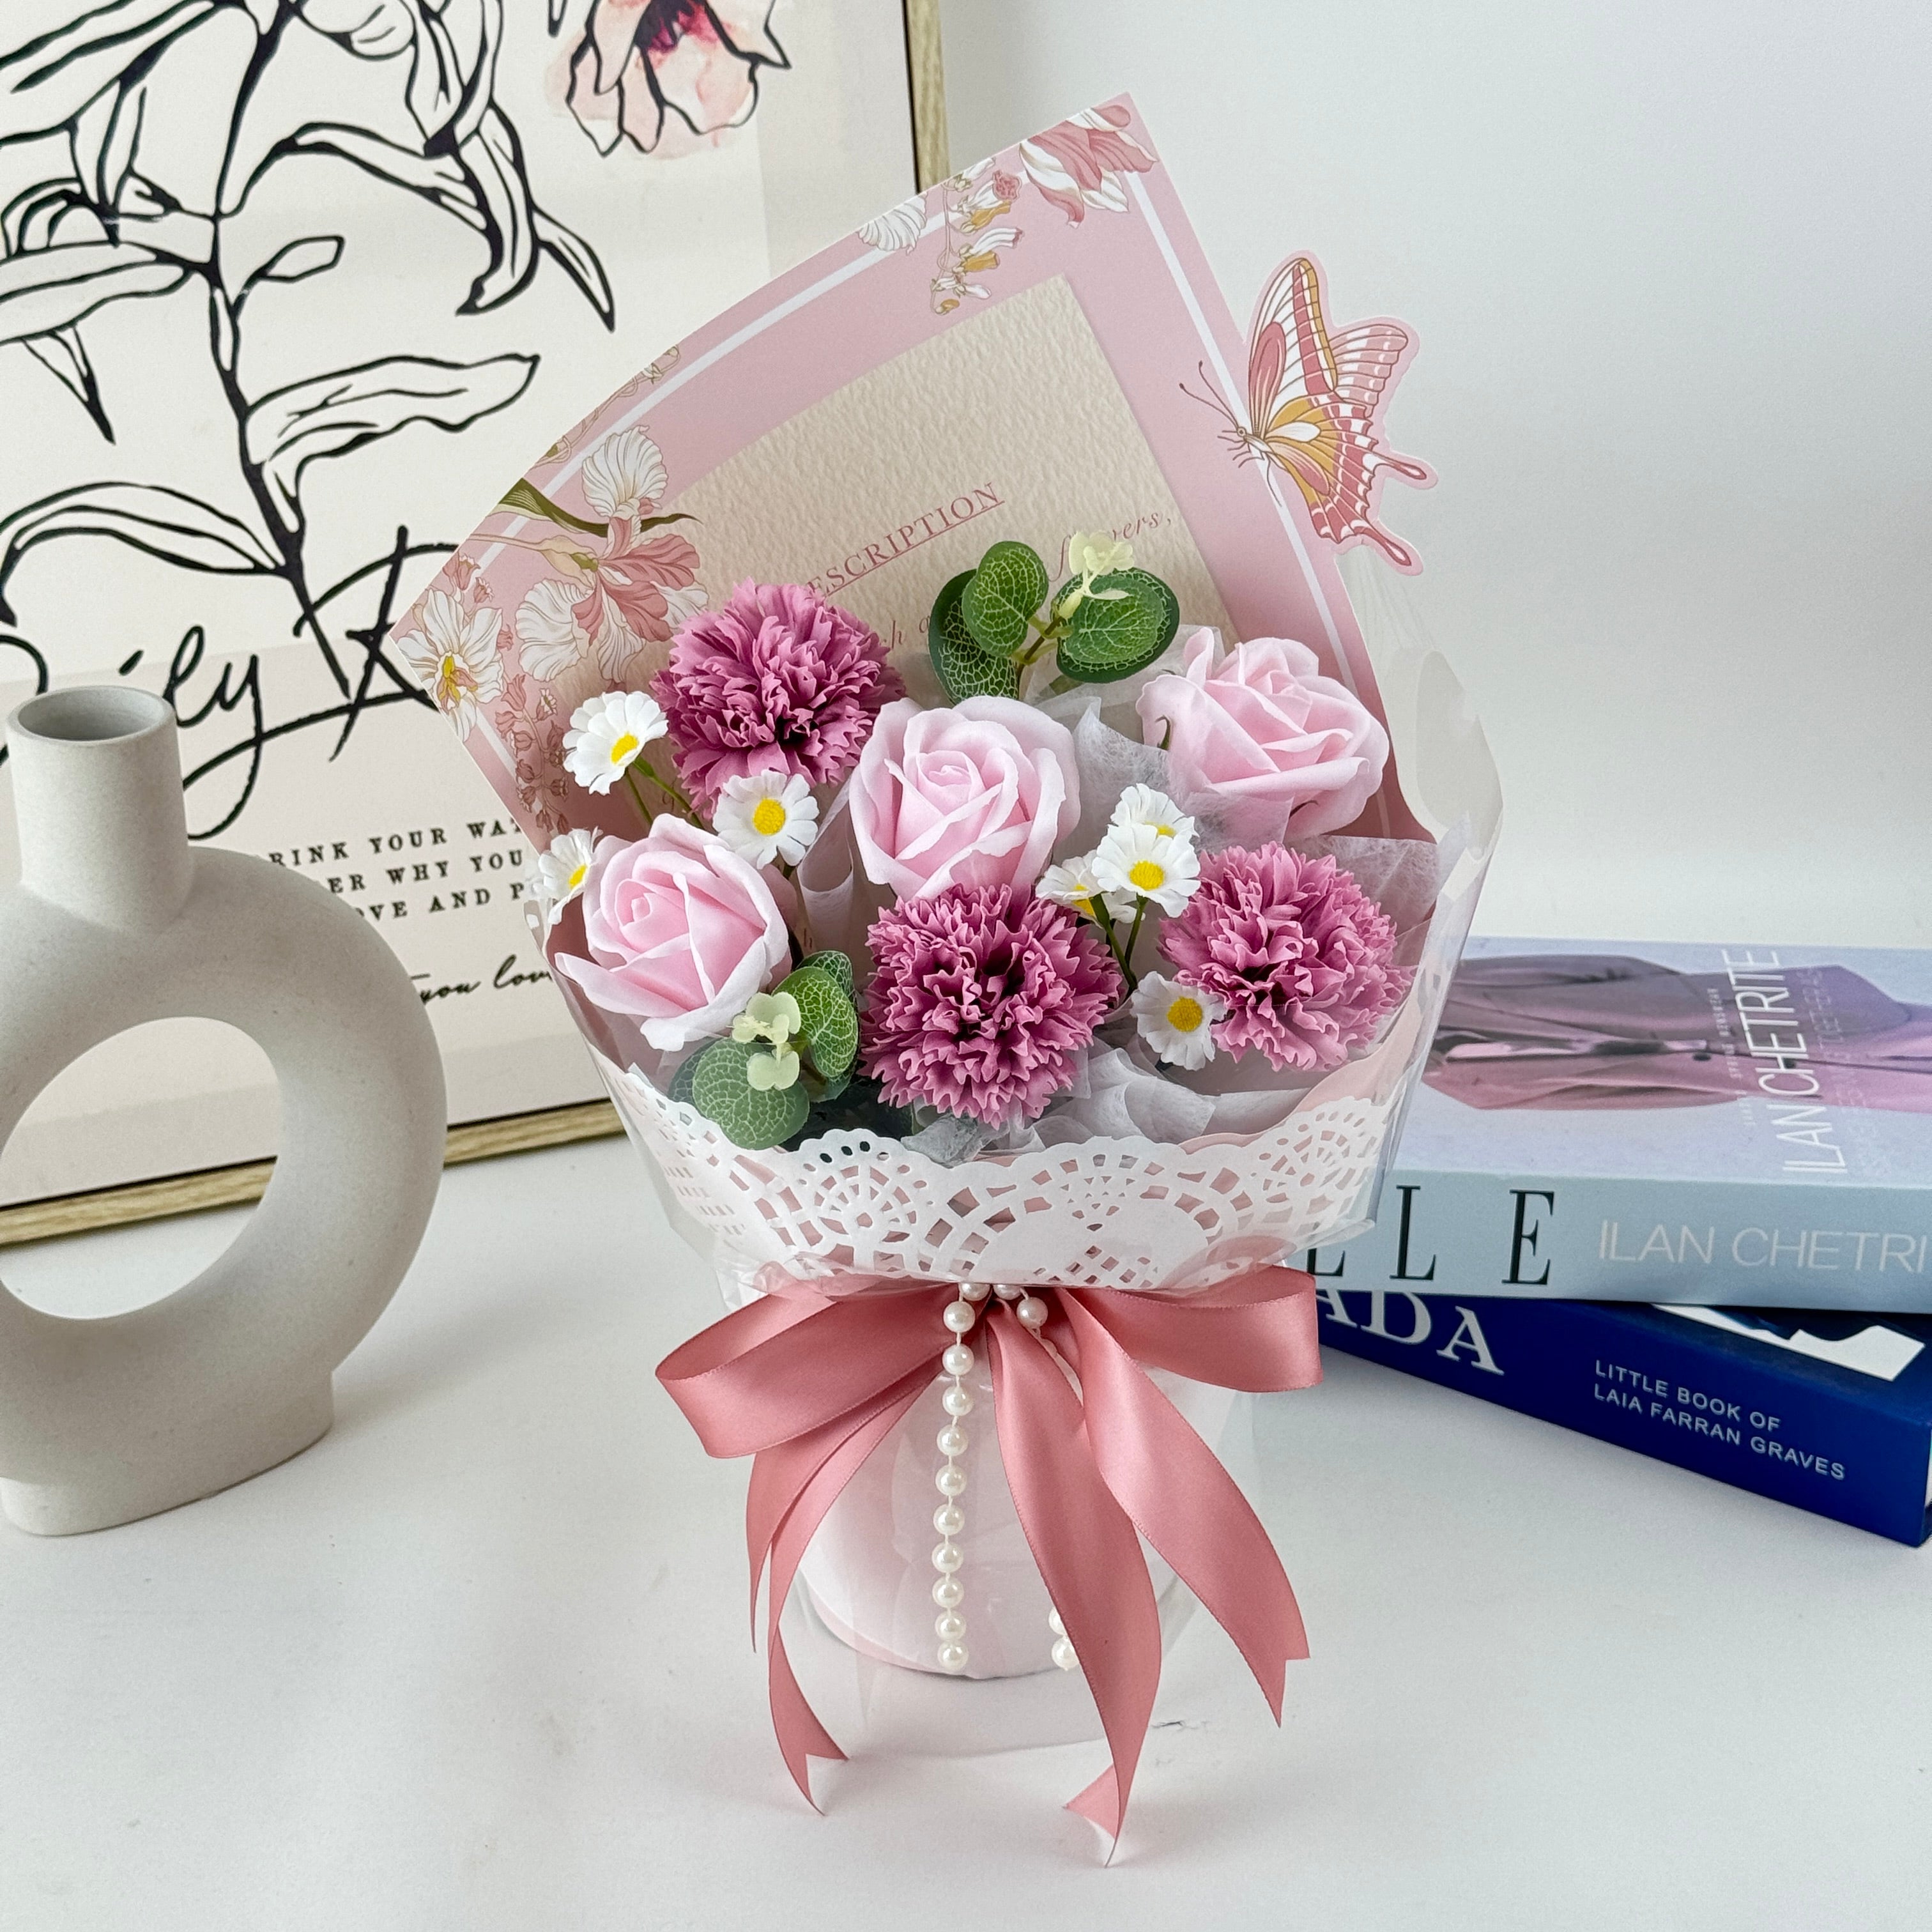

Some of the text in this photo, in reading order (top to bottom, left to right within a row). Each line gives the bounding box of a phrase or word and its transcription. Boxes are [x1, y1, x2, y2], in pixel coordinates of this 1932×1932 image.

[369, 827, 447, 854] YOUR
[386, 860, 449, 885] WHY
[470, 849, 522, 871] YOU
[429, 888, 491, 913] AND
[1722, 949, 1820, 1096] CHETRITE
[1766, 1104, 1848, 1173] ILAN
[1599, 1220, 1927, 1273] ILAN CHETRI
[1596, 1360, 1781, 1432] LITTLE BOOK OF
[1595, 1383, 1845, 1481] LAIA FARRAN GRAVES
